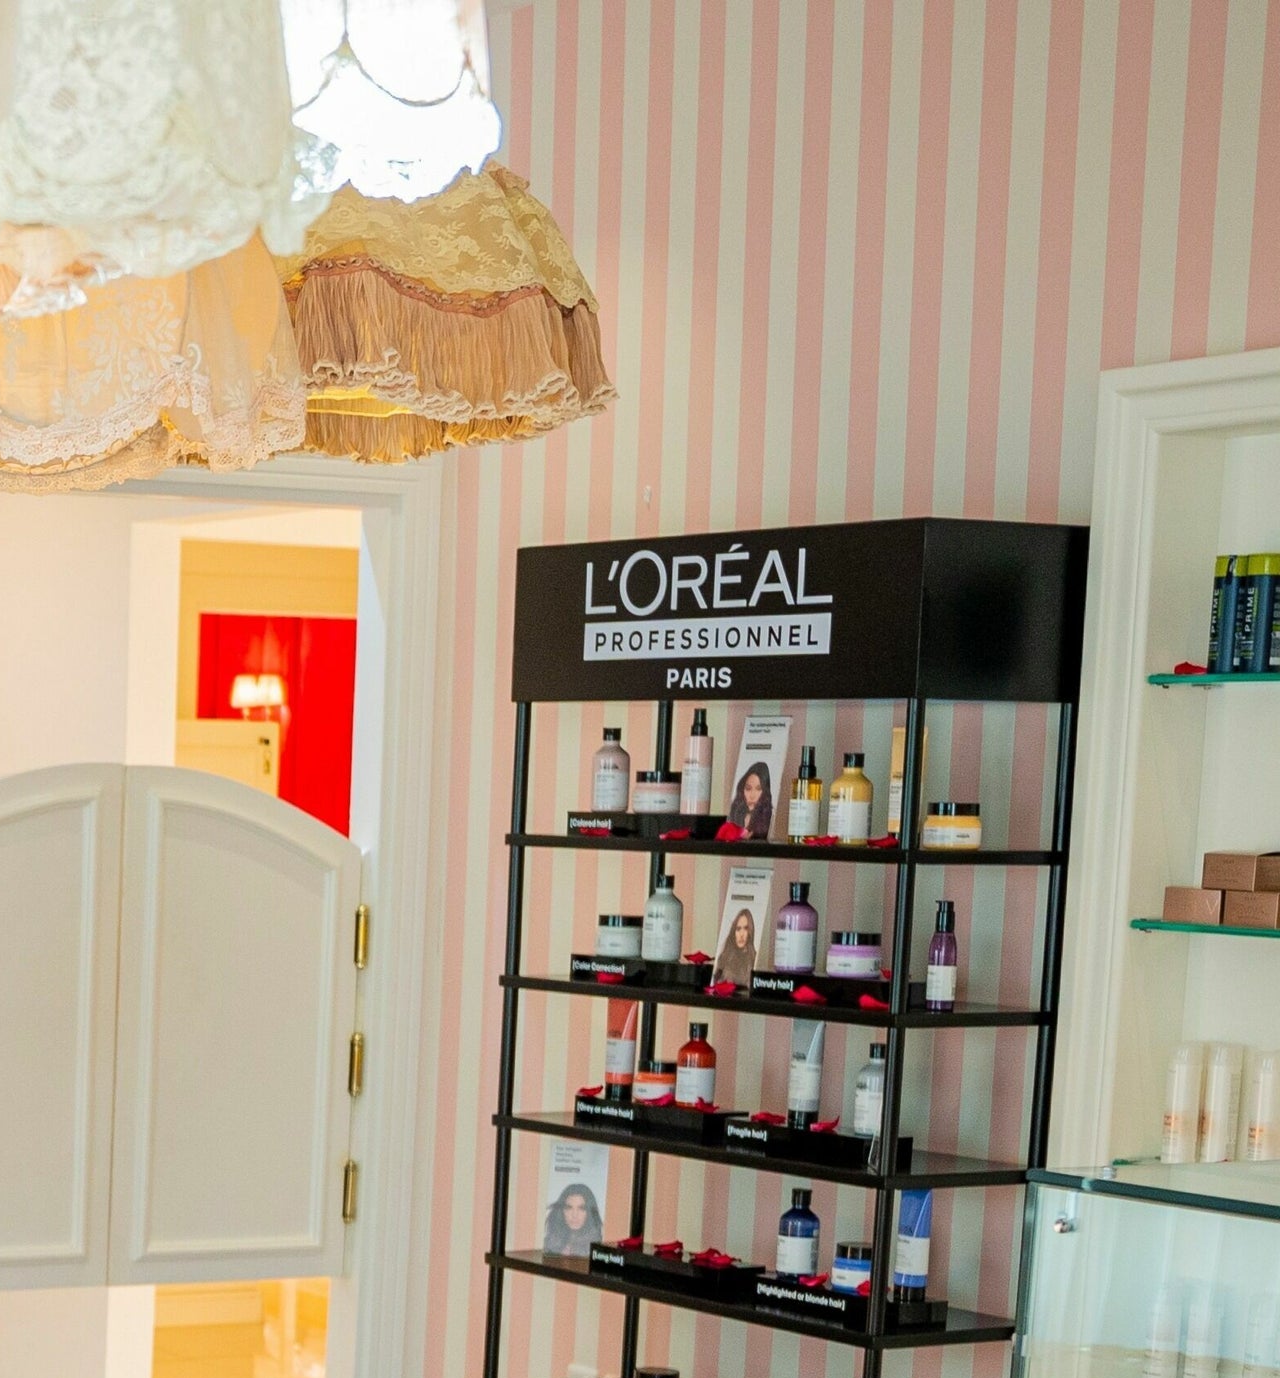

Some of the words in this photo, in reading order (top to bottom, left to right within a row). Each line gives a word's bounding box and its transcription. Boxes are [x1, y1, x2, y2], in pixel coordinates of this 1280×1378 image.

[585, 543, 833, 617] L'ORÉAL
[1244, 587, 1255, 632] PRIME
[594, 624, 819, 652] PROFESSIONNEL
[666, 666, 732, 688] PARIS
[572, 959, 590, 971] [Color
[753, 976, 776, 990] [Unruly
[777, 979, 793, 992] hair]
[601, 1105, 618, 1117] white
[618, 1107, 633, 1121] hair]
[727, 1124, 751, 1138] [Fragile
[752, 1128, 767, 1142] hair]
[592, 1249, 609, 1264] [Long
[609, 1253, 624, 1266] hair]
[757, 1282, 797, 1299] [Highlighted
[797, 1293, 805, 1301] or
[805, 1292, 828, 1306] blonde
[828, 1298, 845, 1311] hair]
